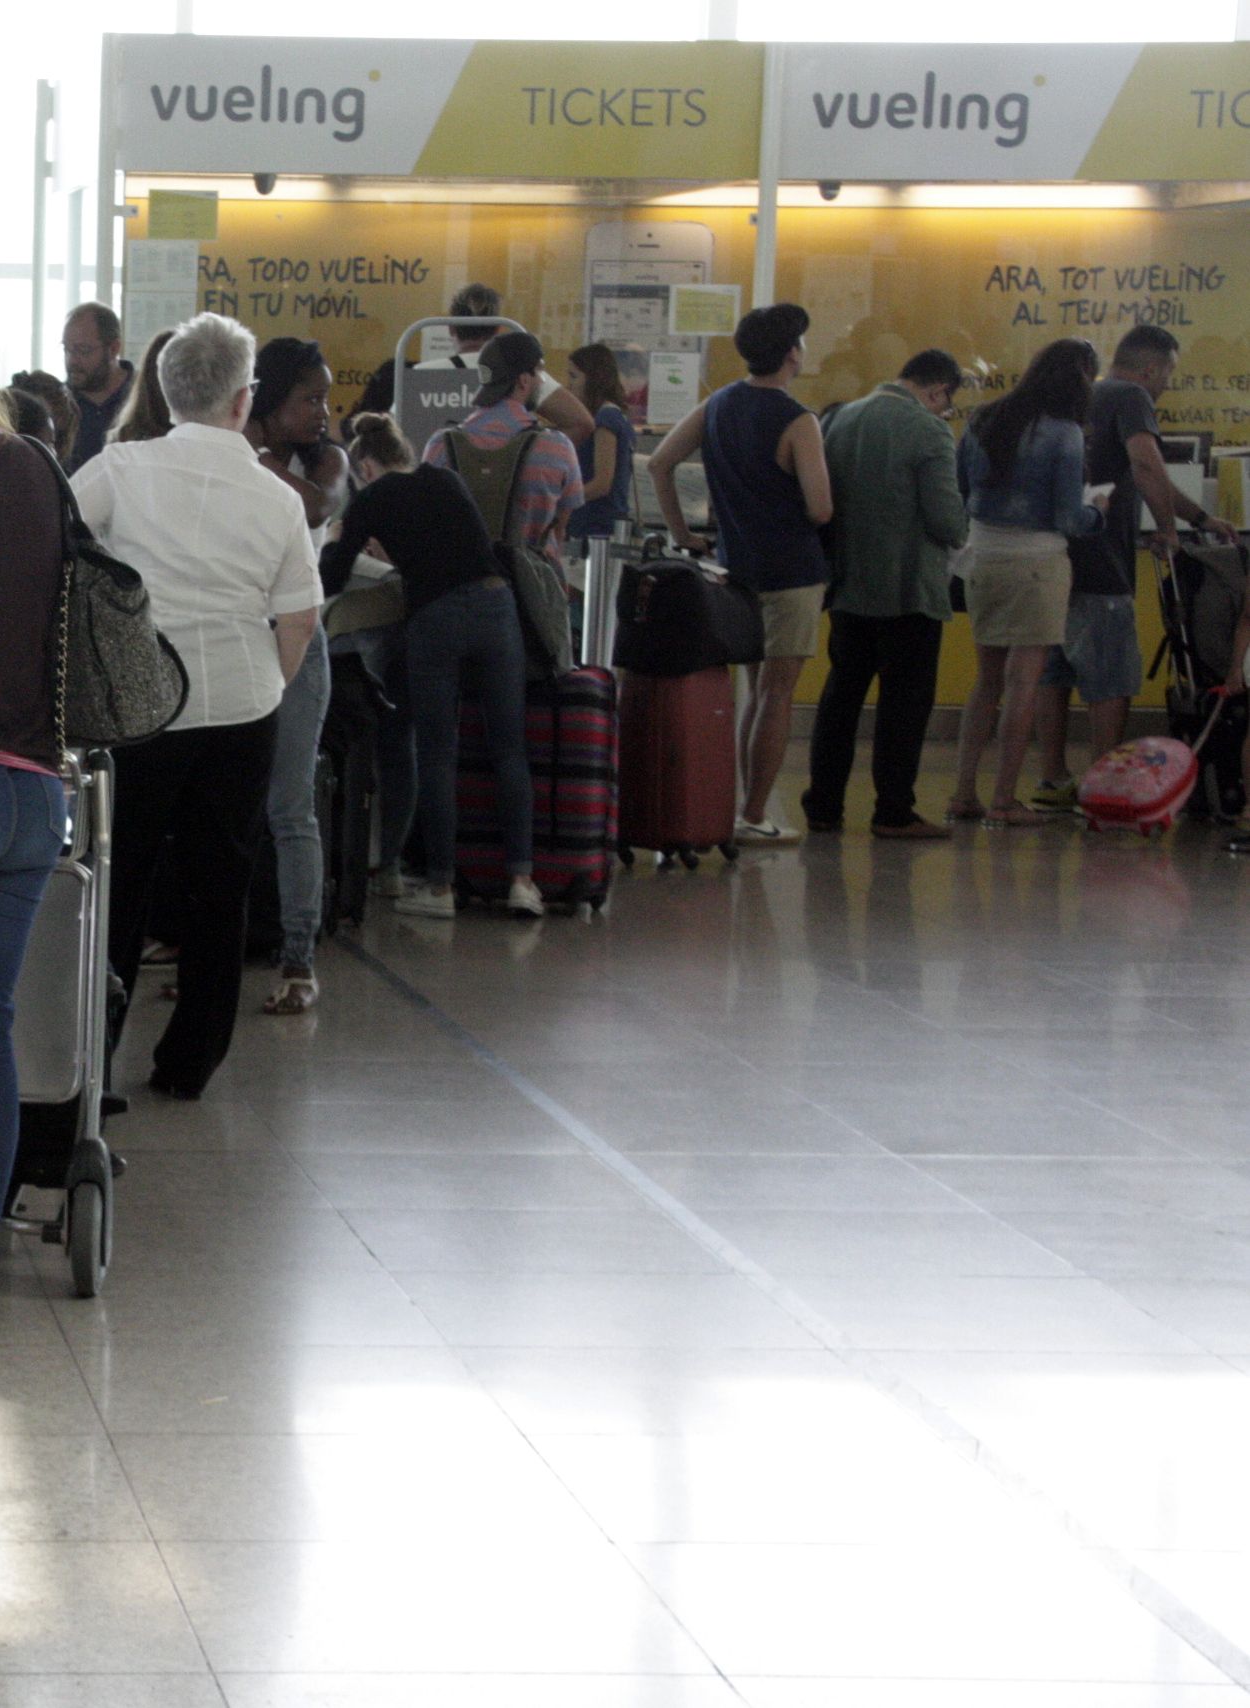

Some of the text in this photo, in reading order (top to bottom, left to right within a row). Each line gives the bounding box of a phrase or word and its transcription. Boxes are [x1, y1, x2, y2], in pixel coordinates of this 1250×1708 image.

[150, 64, 706, 142] vueling TICKETS
[813, 71, 1046, 147] vueling
[248, 257, 310, 283] TODO
[984, 264, 1047, 295] ARA,
[1059, 266, 1106, 291] TOT
[248, 290, 283, 318] TU
[1011, 301, 1048, 326] AL
[1059, 300, 1107, 326] TEU
